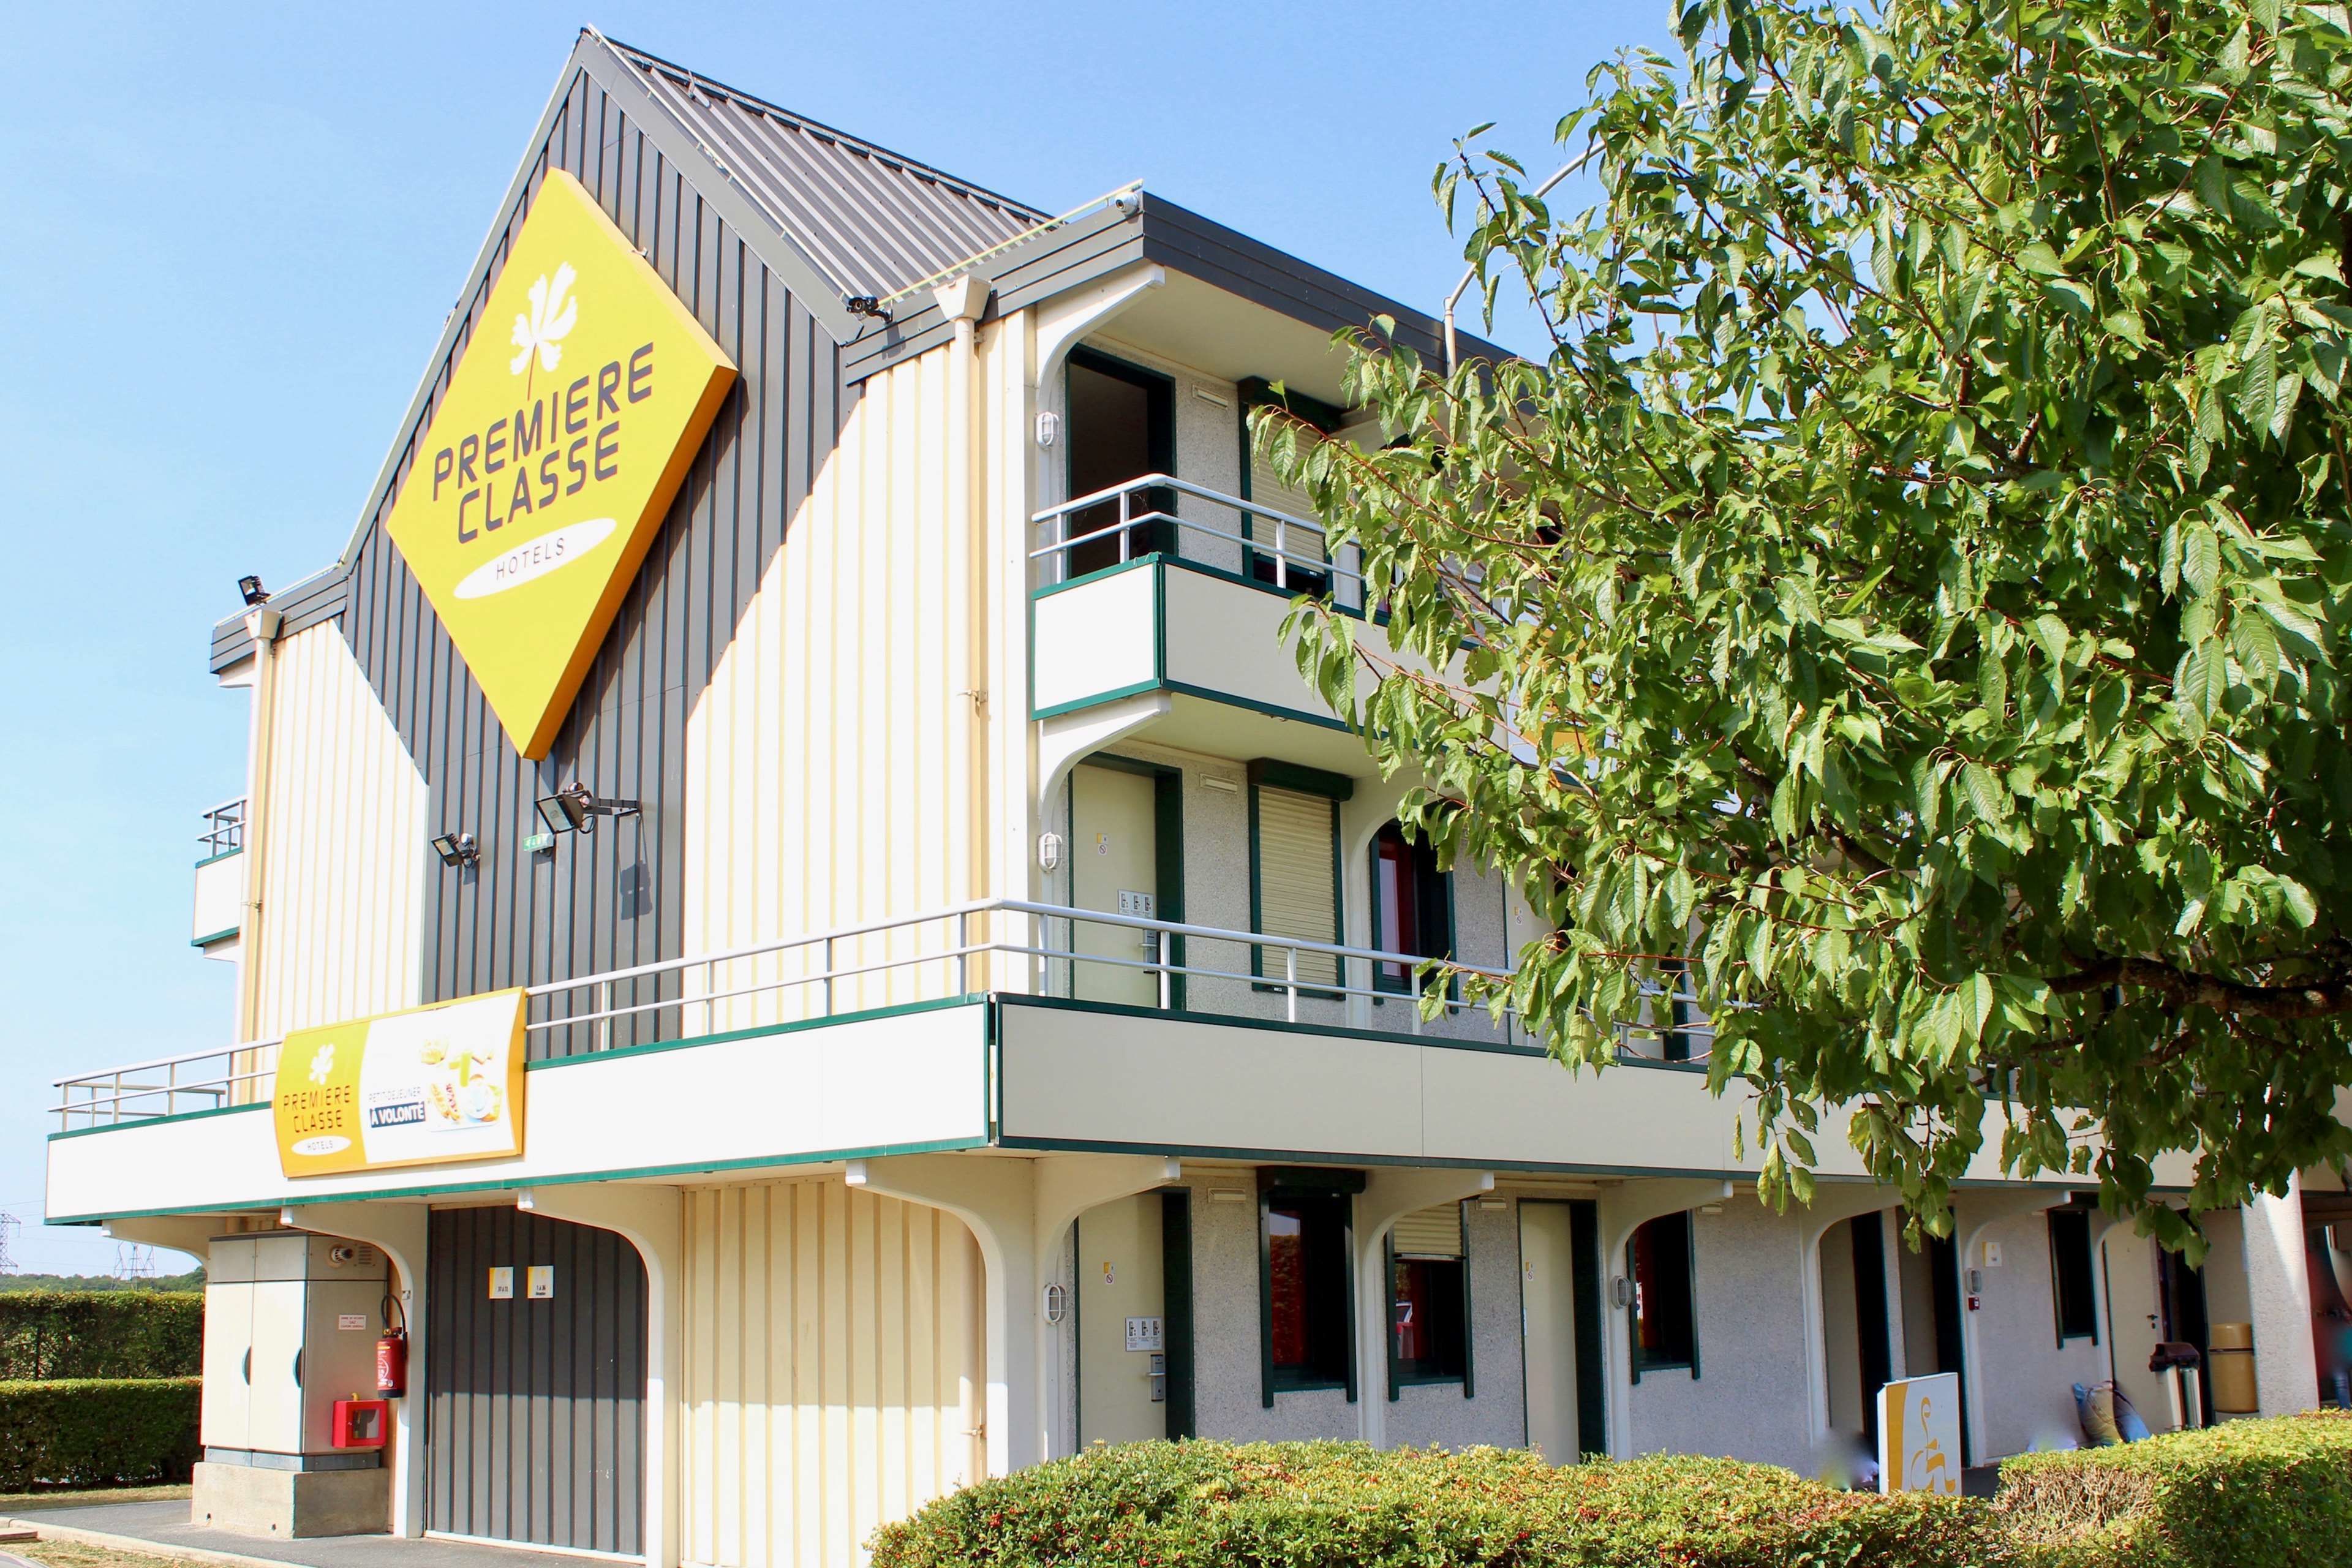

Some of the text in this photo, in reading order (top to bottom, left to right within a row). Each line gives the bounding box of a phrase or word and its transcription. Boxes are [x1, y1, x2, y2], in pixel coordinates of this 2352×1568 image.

[433, 341, 654, 502] PREMIERE
[458, 420, 620, 545] CLASSE
[496, 537, 565, 581] HOTELS
[284, 1085, 351, 1113] PREMIERE
[294, 1109, 342, 1133] CLASSE
[307, 1140, 334, 1151] HOTELS
